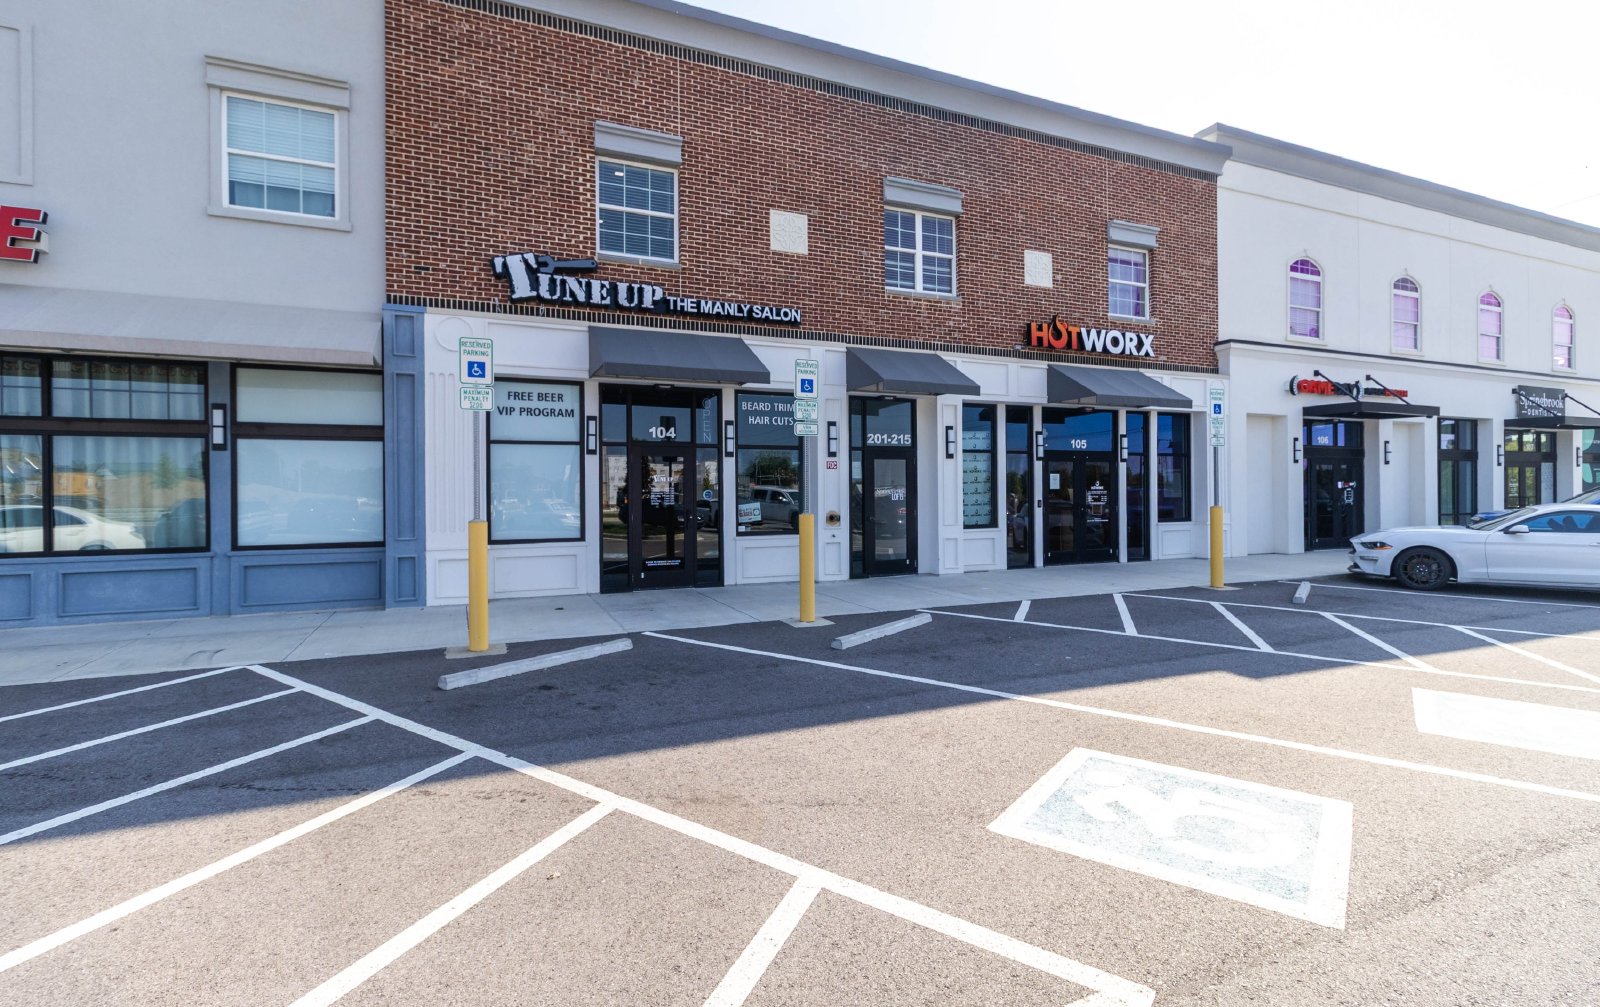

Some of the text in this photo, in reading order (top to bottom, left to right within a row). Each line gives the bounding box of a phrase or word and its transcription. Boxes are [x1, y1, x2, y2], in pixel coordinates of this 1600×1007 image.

[666, 296, 801, 323] THE MANLY SALON
[461, 340, 491, 349] RESERVED
[463, 349, 489, 357] PARKING
[507, 391, 564, 403] FREE BEER
[741, 401, 771, 411] BEARD
[496, 406, 575, 418] VIP PROGRAM
[748, 415, 794, 426] HAIR CUTS
[649, 427, 677, 439] 104
[866, 433, 912, 445] 201-215
[1070, 439, 1087, 449] 105
[1317, 436, 1329, 444] 106
